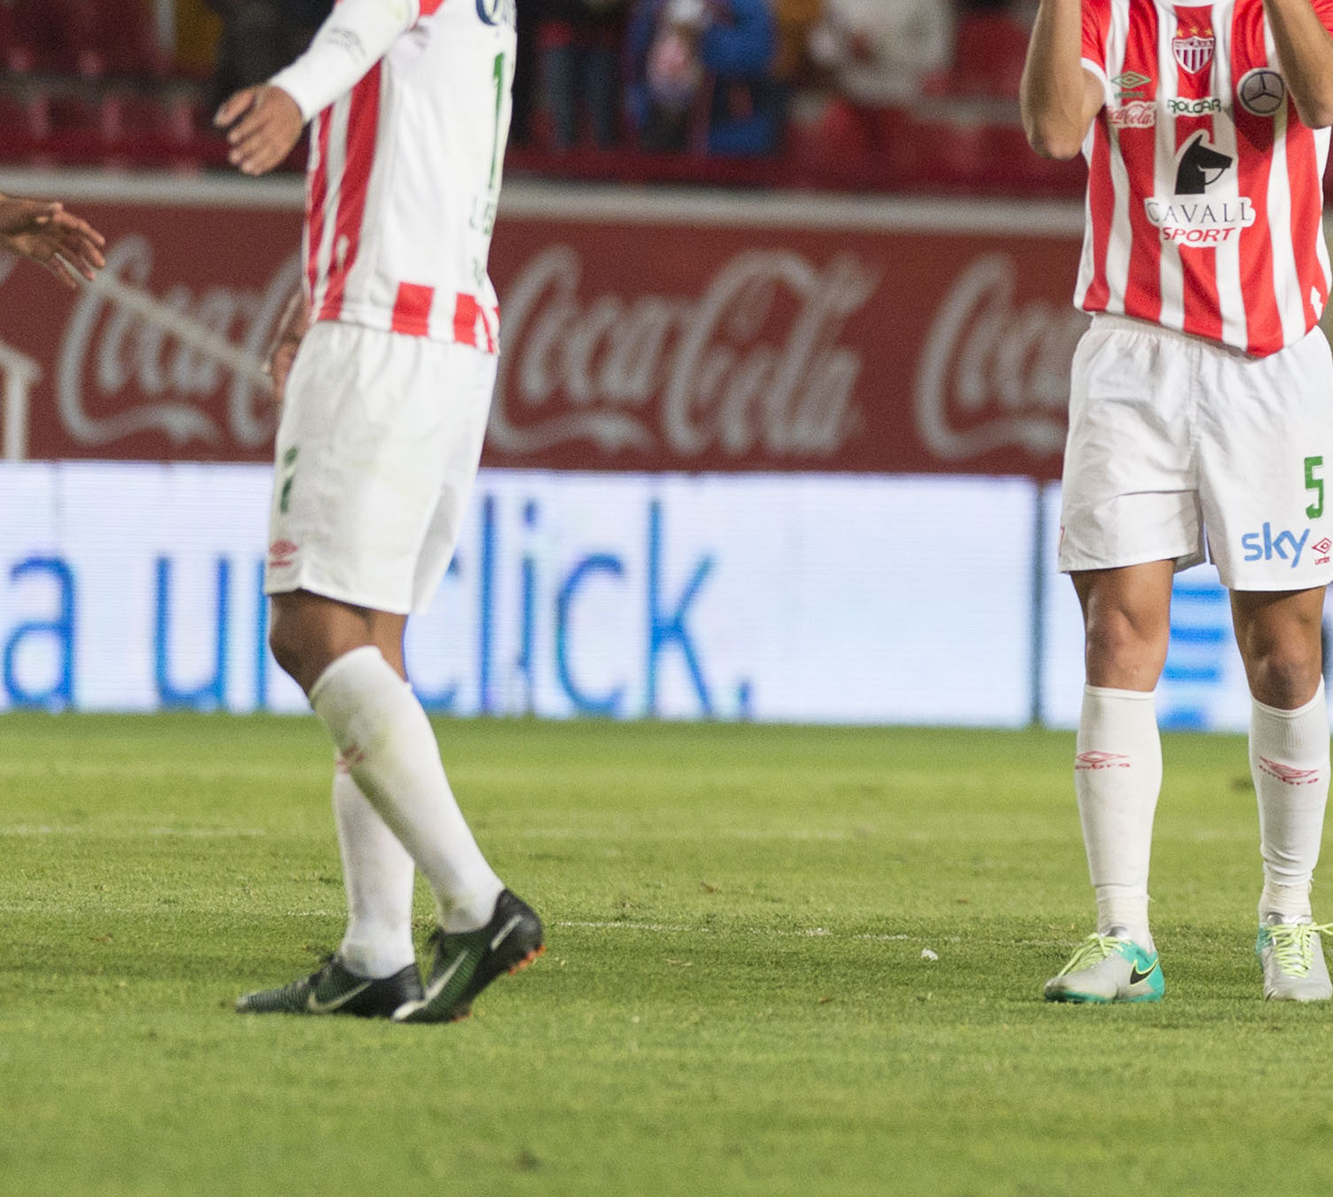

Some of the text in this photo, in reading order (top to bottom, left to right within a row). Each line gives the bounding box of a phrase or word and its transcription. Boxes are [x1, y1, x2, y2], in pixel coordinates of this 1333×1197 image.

[1168, 99, 1222, 114] ROLCAR
[1163, 226, 1236, 242] SPORT
[1304, 455, 1324, 520] 5
[1241, 522, 1311, 568] sky
[4, 556, 77, 712] a
